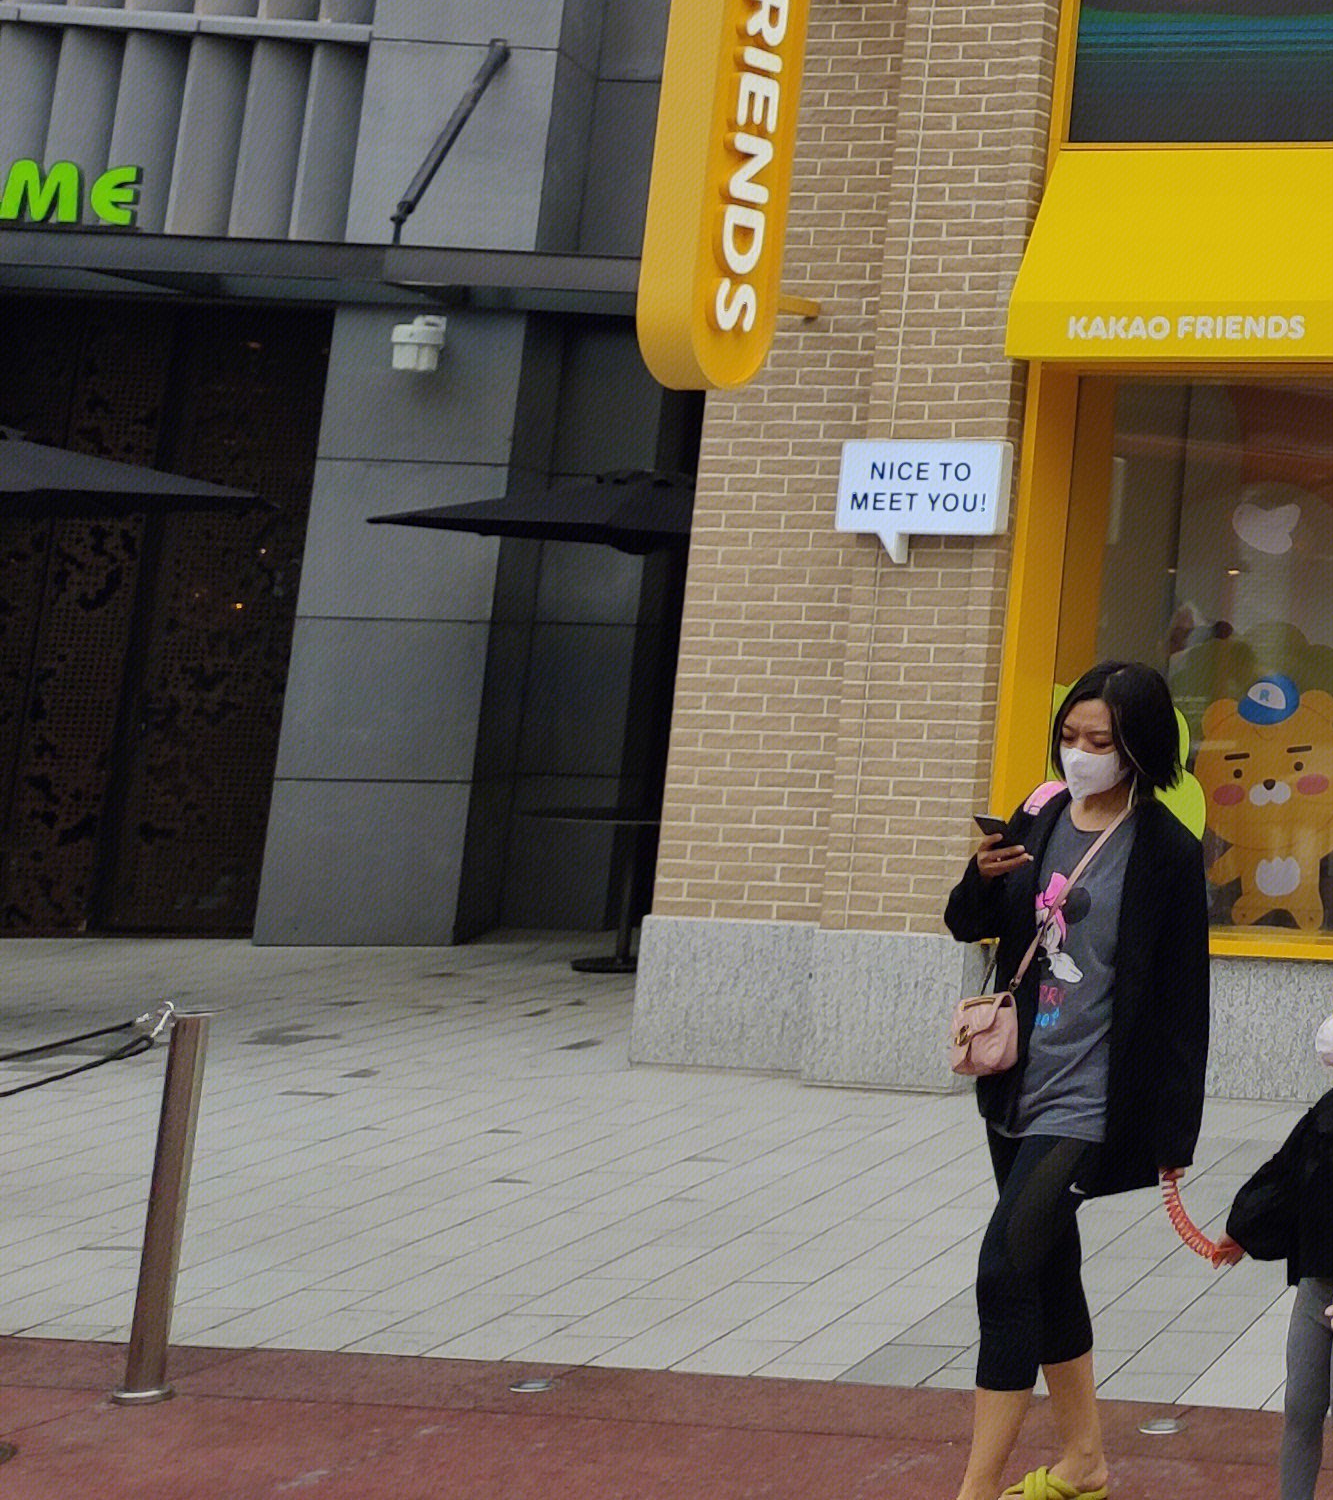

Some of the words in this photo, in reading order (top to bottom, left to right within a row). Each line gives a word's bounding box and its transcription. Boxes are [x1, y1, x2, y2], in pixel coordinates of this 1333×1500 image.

[1066, 315, 1171, 341] KAKAO
[1177, 315, 1306, 341] FRIENDS
[869, 461, 931, 482] NICE
[939, 462, 972, 483] TO
[850, 491, 919, 512] MEET
[927, 492, 987, 513] YOU!
